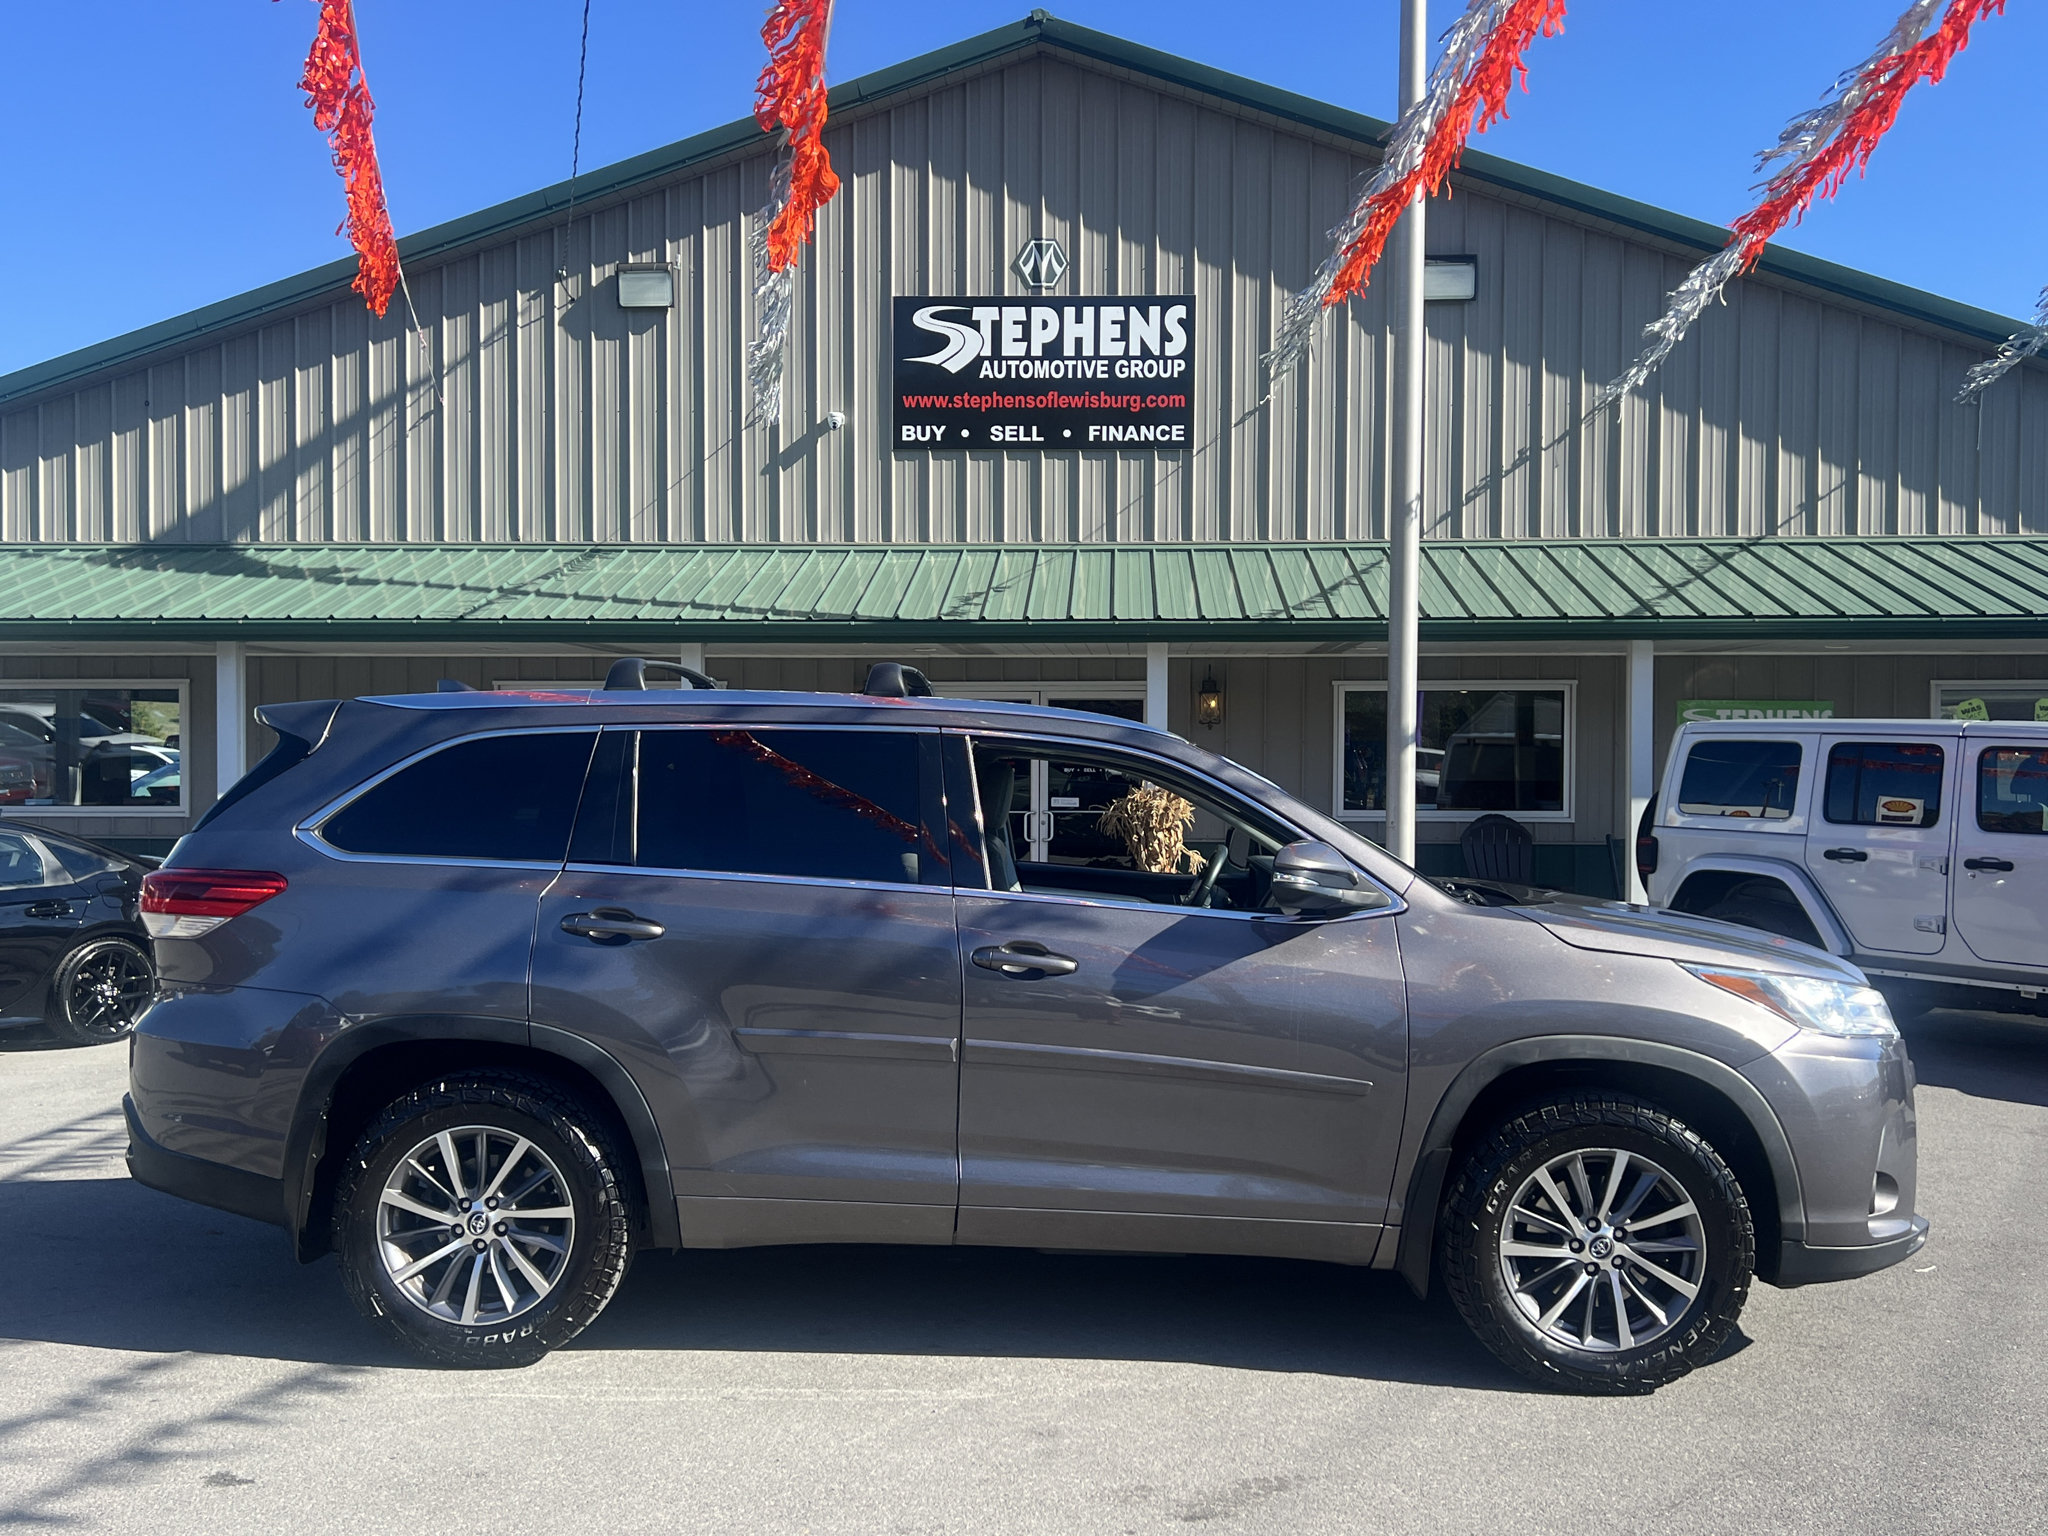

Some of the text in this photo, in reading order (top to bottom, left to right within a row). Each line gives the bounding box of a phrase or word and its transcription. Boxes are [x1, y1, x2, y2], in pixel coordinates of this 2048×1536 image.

[903, 304, 1187, 374] STEPHENS
[979, 359, 1186, 379] AUTOMOTIVE GROUP
[903, 391, 1186, 412] www.stephensoflewisburg.com
[902, 425, 1185, 441] BUY SELL FINANCE
